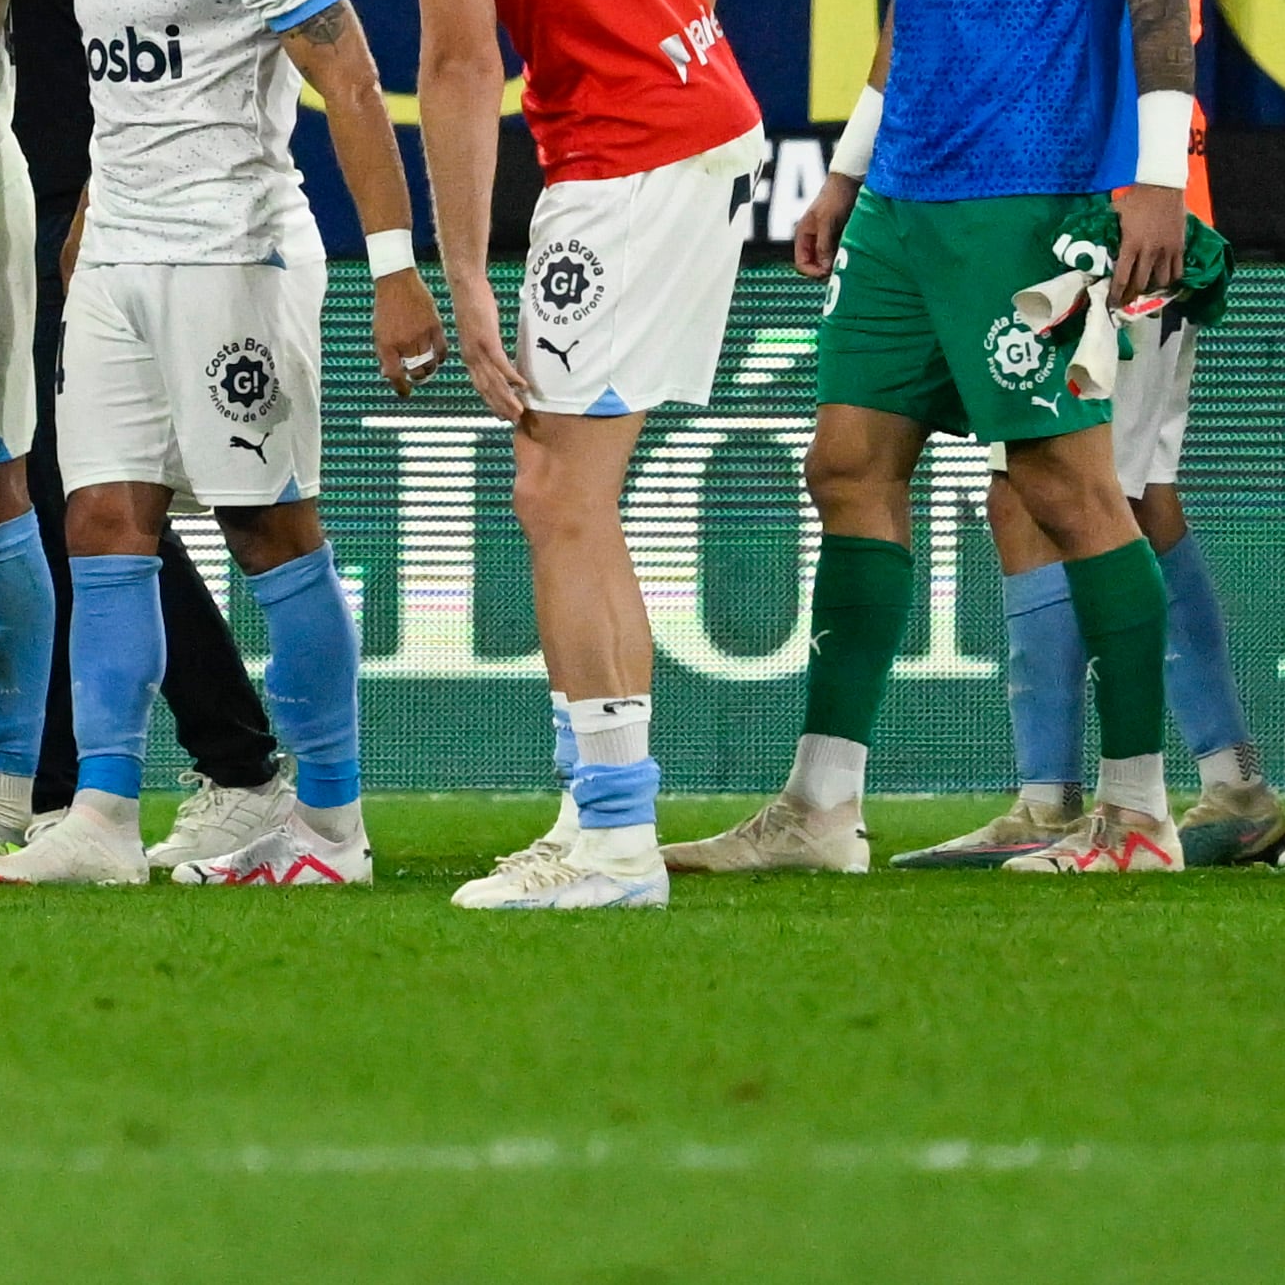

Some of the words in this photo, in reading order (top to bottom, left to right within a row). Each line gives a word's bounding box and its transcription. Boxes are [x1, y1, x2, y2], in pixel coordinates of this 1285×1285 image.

[532, 242, 563, 275] Costa
[568, 239, 604, 276] Brava
[553, 315, 568, 325] de
[572, 285, 605, 321] Girona
[984, 317, 1010, 350] Costa
[205, 342, 240, 377] Costa
[244, 337, 275, 371] Brava
[1019, 381, 1034, 390] de
[1035, 346, 1056, 383] Girona
[208, 385, 239, 422] Pirineu
[243, 412, 257, 423] de
[259, 377, 280, 416] Girona
